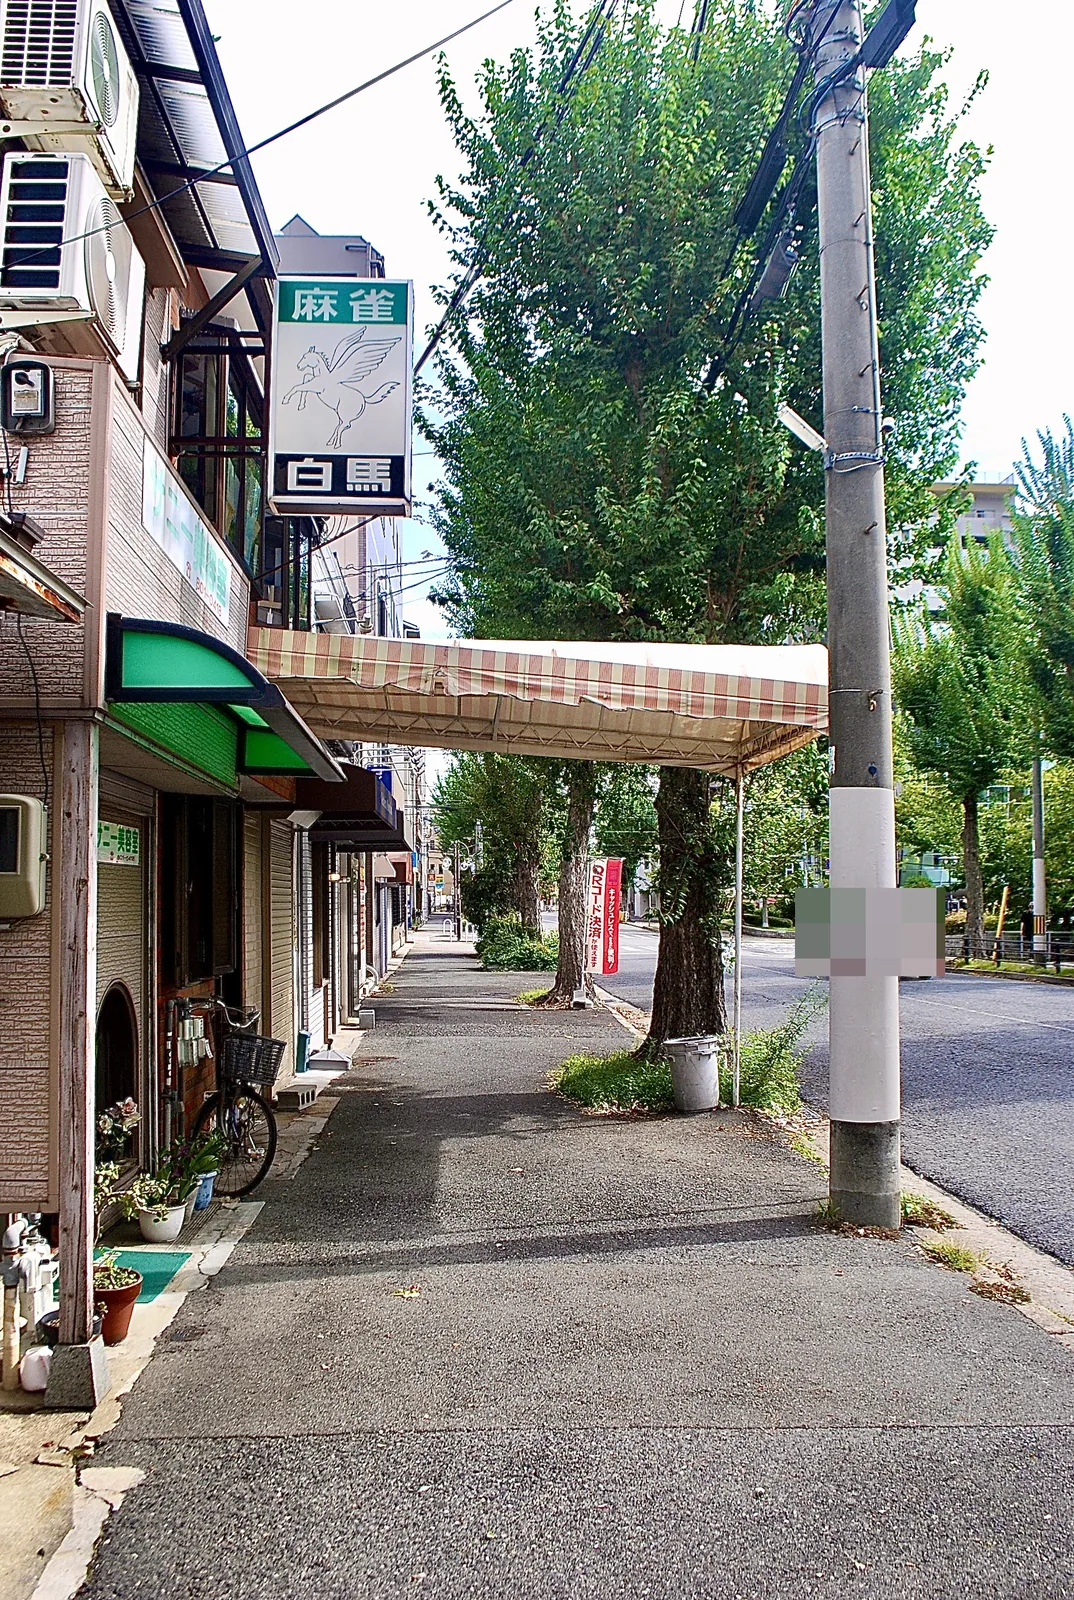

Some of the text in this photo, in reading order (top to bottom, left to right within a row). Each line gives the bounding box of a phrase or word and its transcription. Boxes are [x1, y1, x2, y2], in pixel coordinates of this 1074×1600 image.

[291, 287, 395, 322] 麻雀
[286, 457, 392, 492] 白馬
[150, 454, 227, 608] サニー美容室
